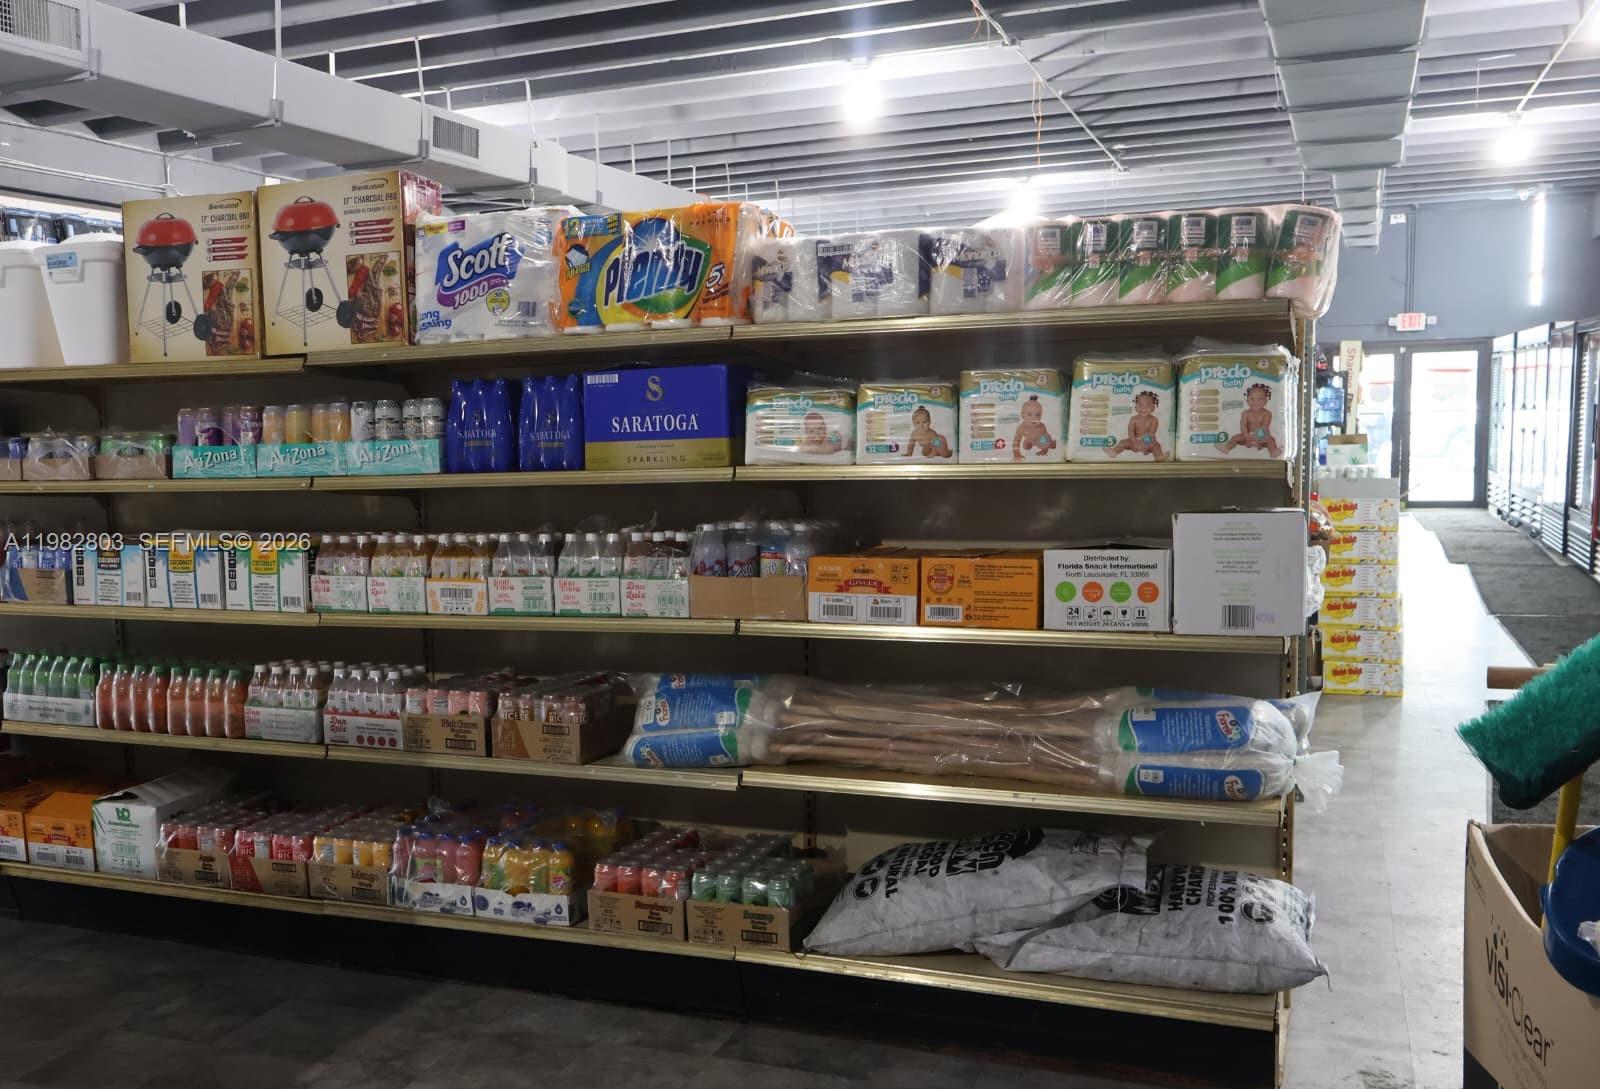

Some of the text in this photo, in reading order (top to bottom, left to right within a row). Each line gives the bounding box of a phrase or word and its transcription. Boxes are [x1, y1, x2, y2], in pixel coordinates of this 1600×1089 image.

[442, 232, 514, 288] Scott
[453, 281, 489, 309] 1000
[419, 310, 440, 320] ong
[1401, 315, 1422, 328] EXIT
[1091, 370, 1141, 387] predo
[1200, 362, 1251, 380] predo
[611, 413, 699, 433] SARATOGA
[626, 455, 687, 464] SPARKLING
[1068, 607, 1080, 616] 24
[1217, 884, 1237, 925] 100%
